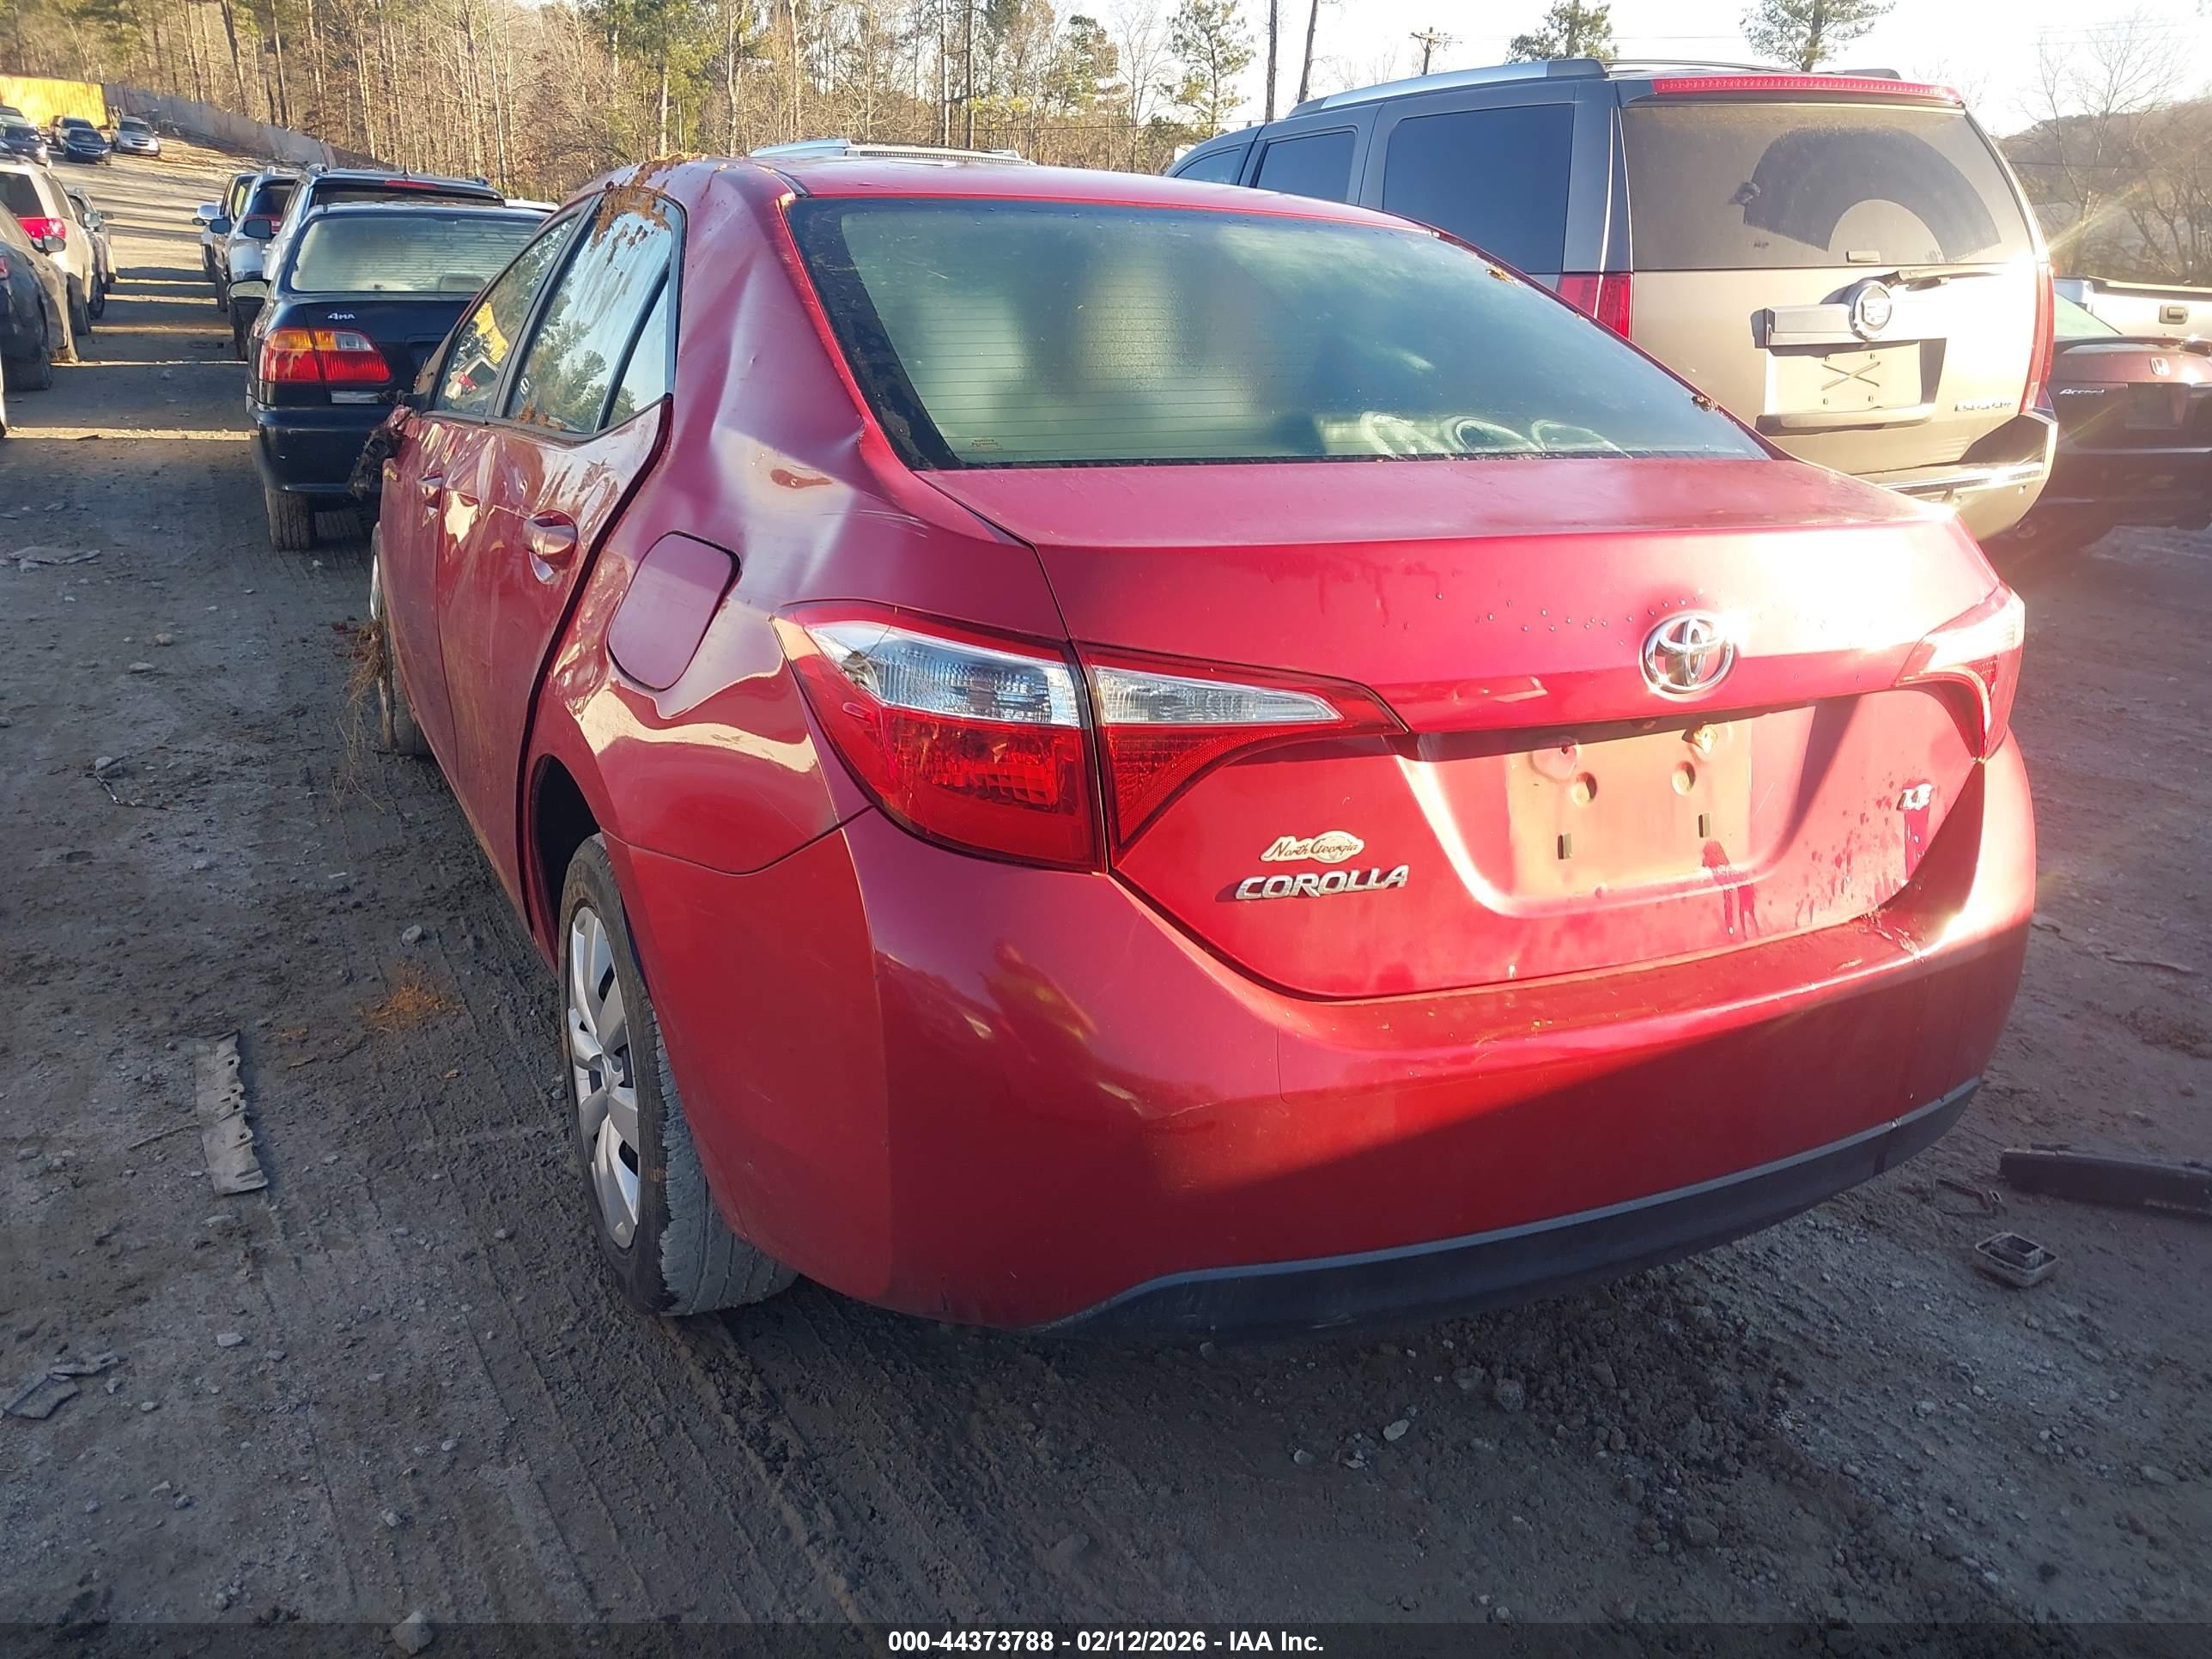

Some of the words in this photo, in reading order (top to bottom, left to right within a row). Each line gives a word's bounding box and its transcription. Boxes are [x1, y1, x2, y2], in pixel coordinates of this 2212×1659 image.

[1263, 838, 1310, 859] North
[1310, 836, 1359, 856] Georgia
[1235, 864, 1410, 901] COROLLA
